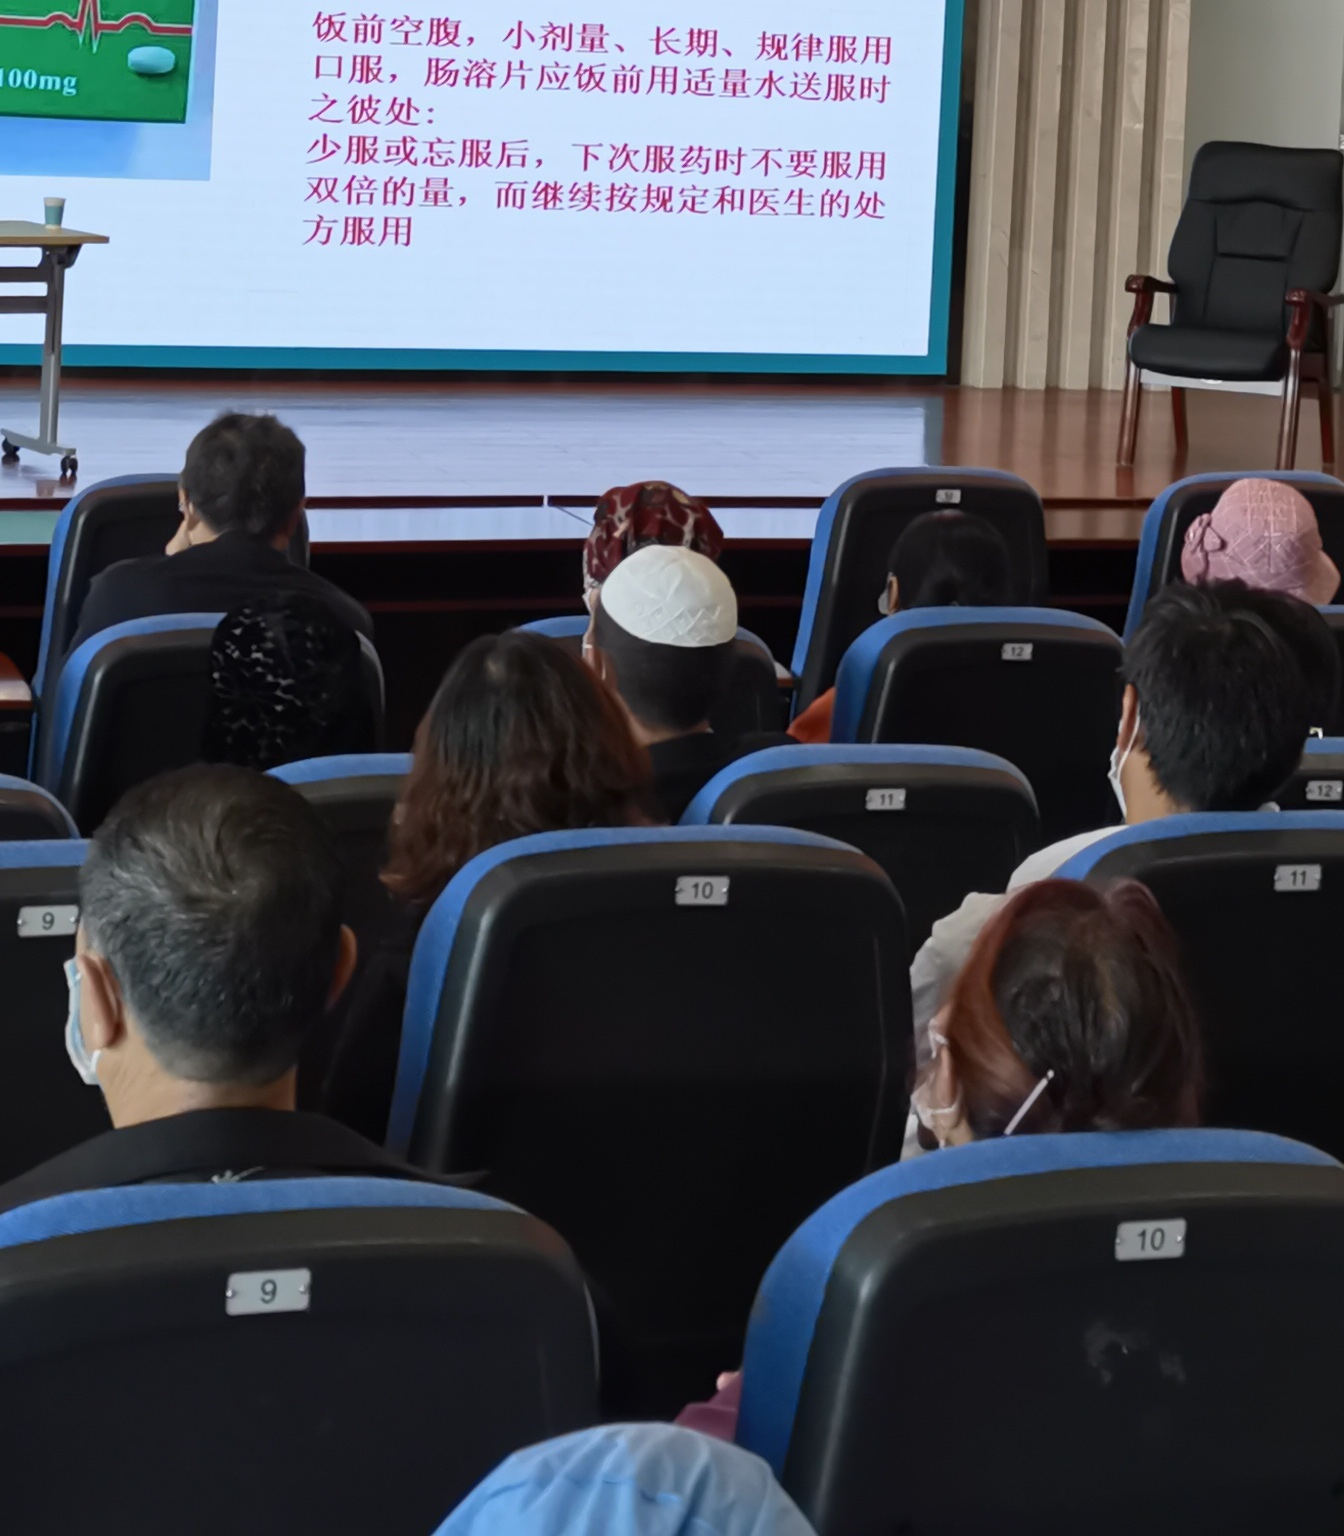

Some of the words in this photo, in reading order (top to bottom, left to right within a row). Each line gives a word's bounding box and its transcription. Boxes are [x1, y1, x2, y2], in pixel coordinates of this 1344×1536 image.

[302, 214, 412, 247] 方服用
[1010, 646, 1025, 657] 12
[879, 792, 894, 807] 11
[1317, 784, 1333, 798] 12
[1289, 869, 1307, 886] 11
[691, 881, 715, 900] 10
[41, 912, 56, 931] 9
[1136, 1227, 1166, 1252] 10
[260, 1279, 278, 1305] 9
